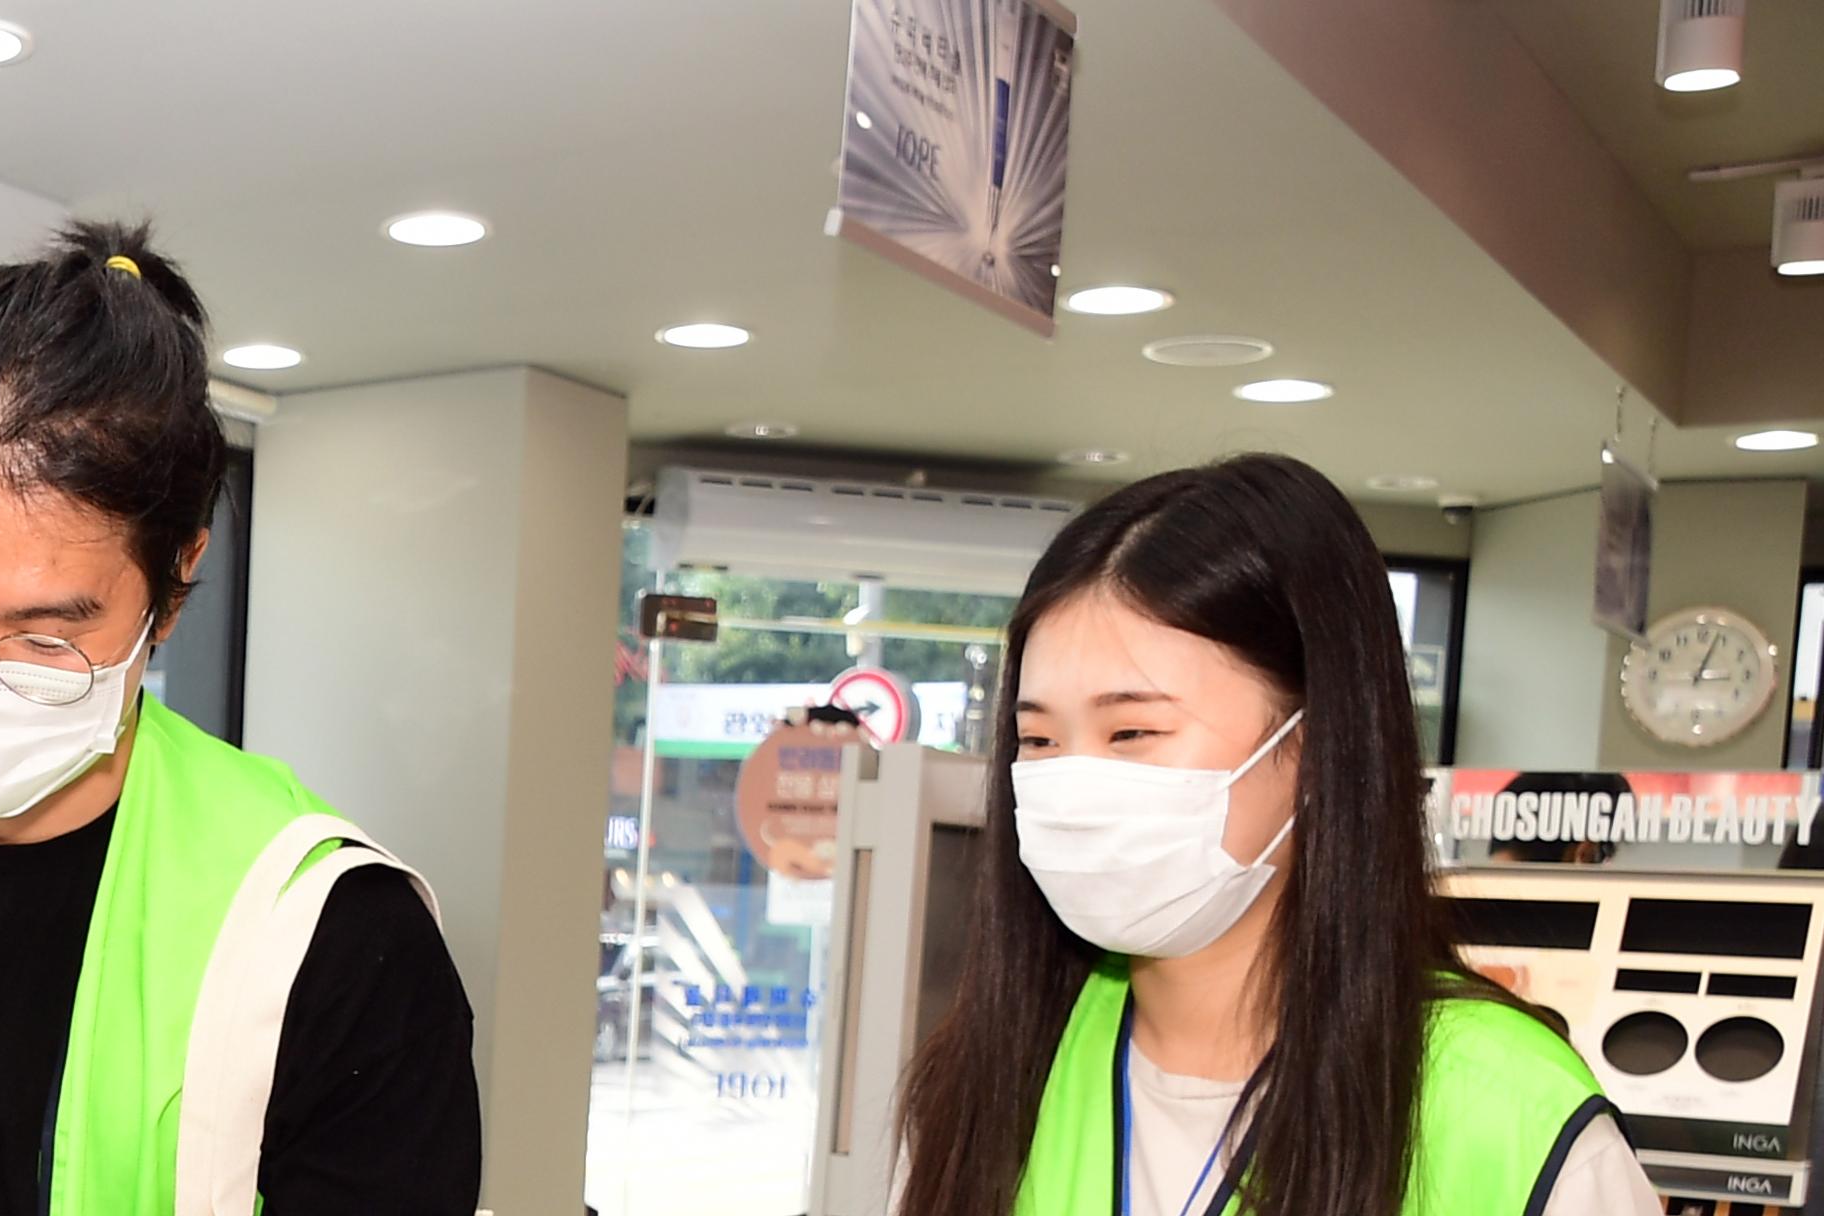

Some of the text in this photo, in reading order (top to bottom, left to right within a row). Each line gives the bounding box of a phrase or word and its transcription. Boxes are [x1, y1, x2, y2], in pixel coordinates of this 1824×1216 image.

[895, 123, 942, 181] IOPE
[1450, 791, 1821, 846] CHOSUNGAH BEAUTY
[1732, 1133, 1781, 1154] INGA
[1727, 1175, 1772, 1195] INGA
